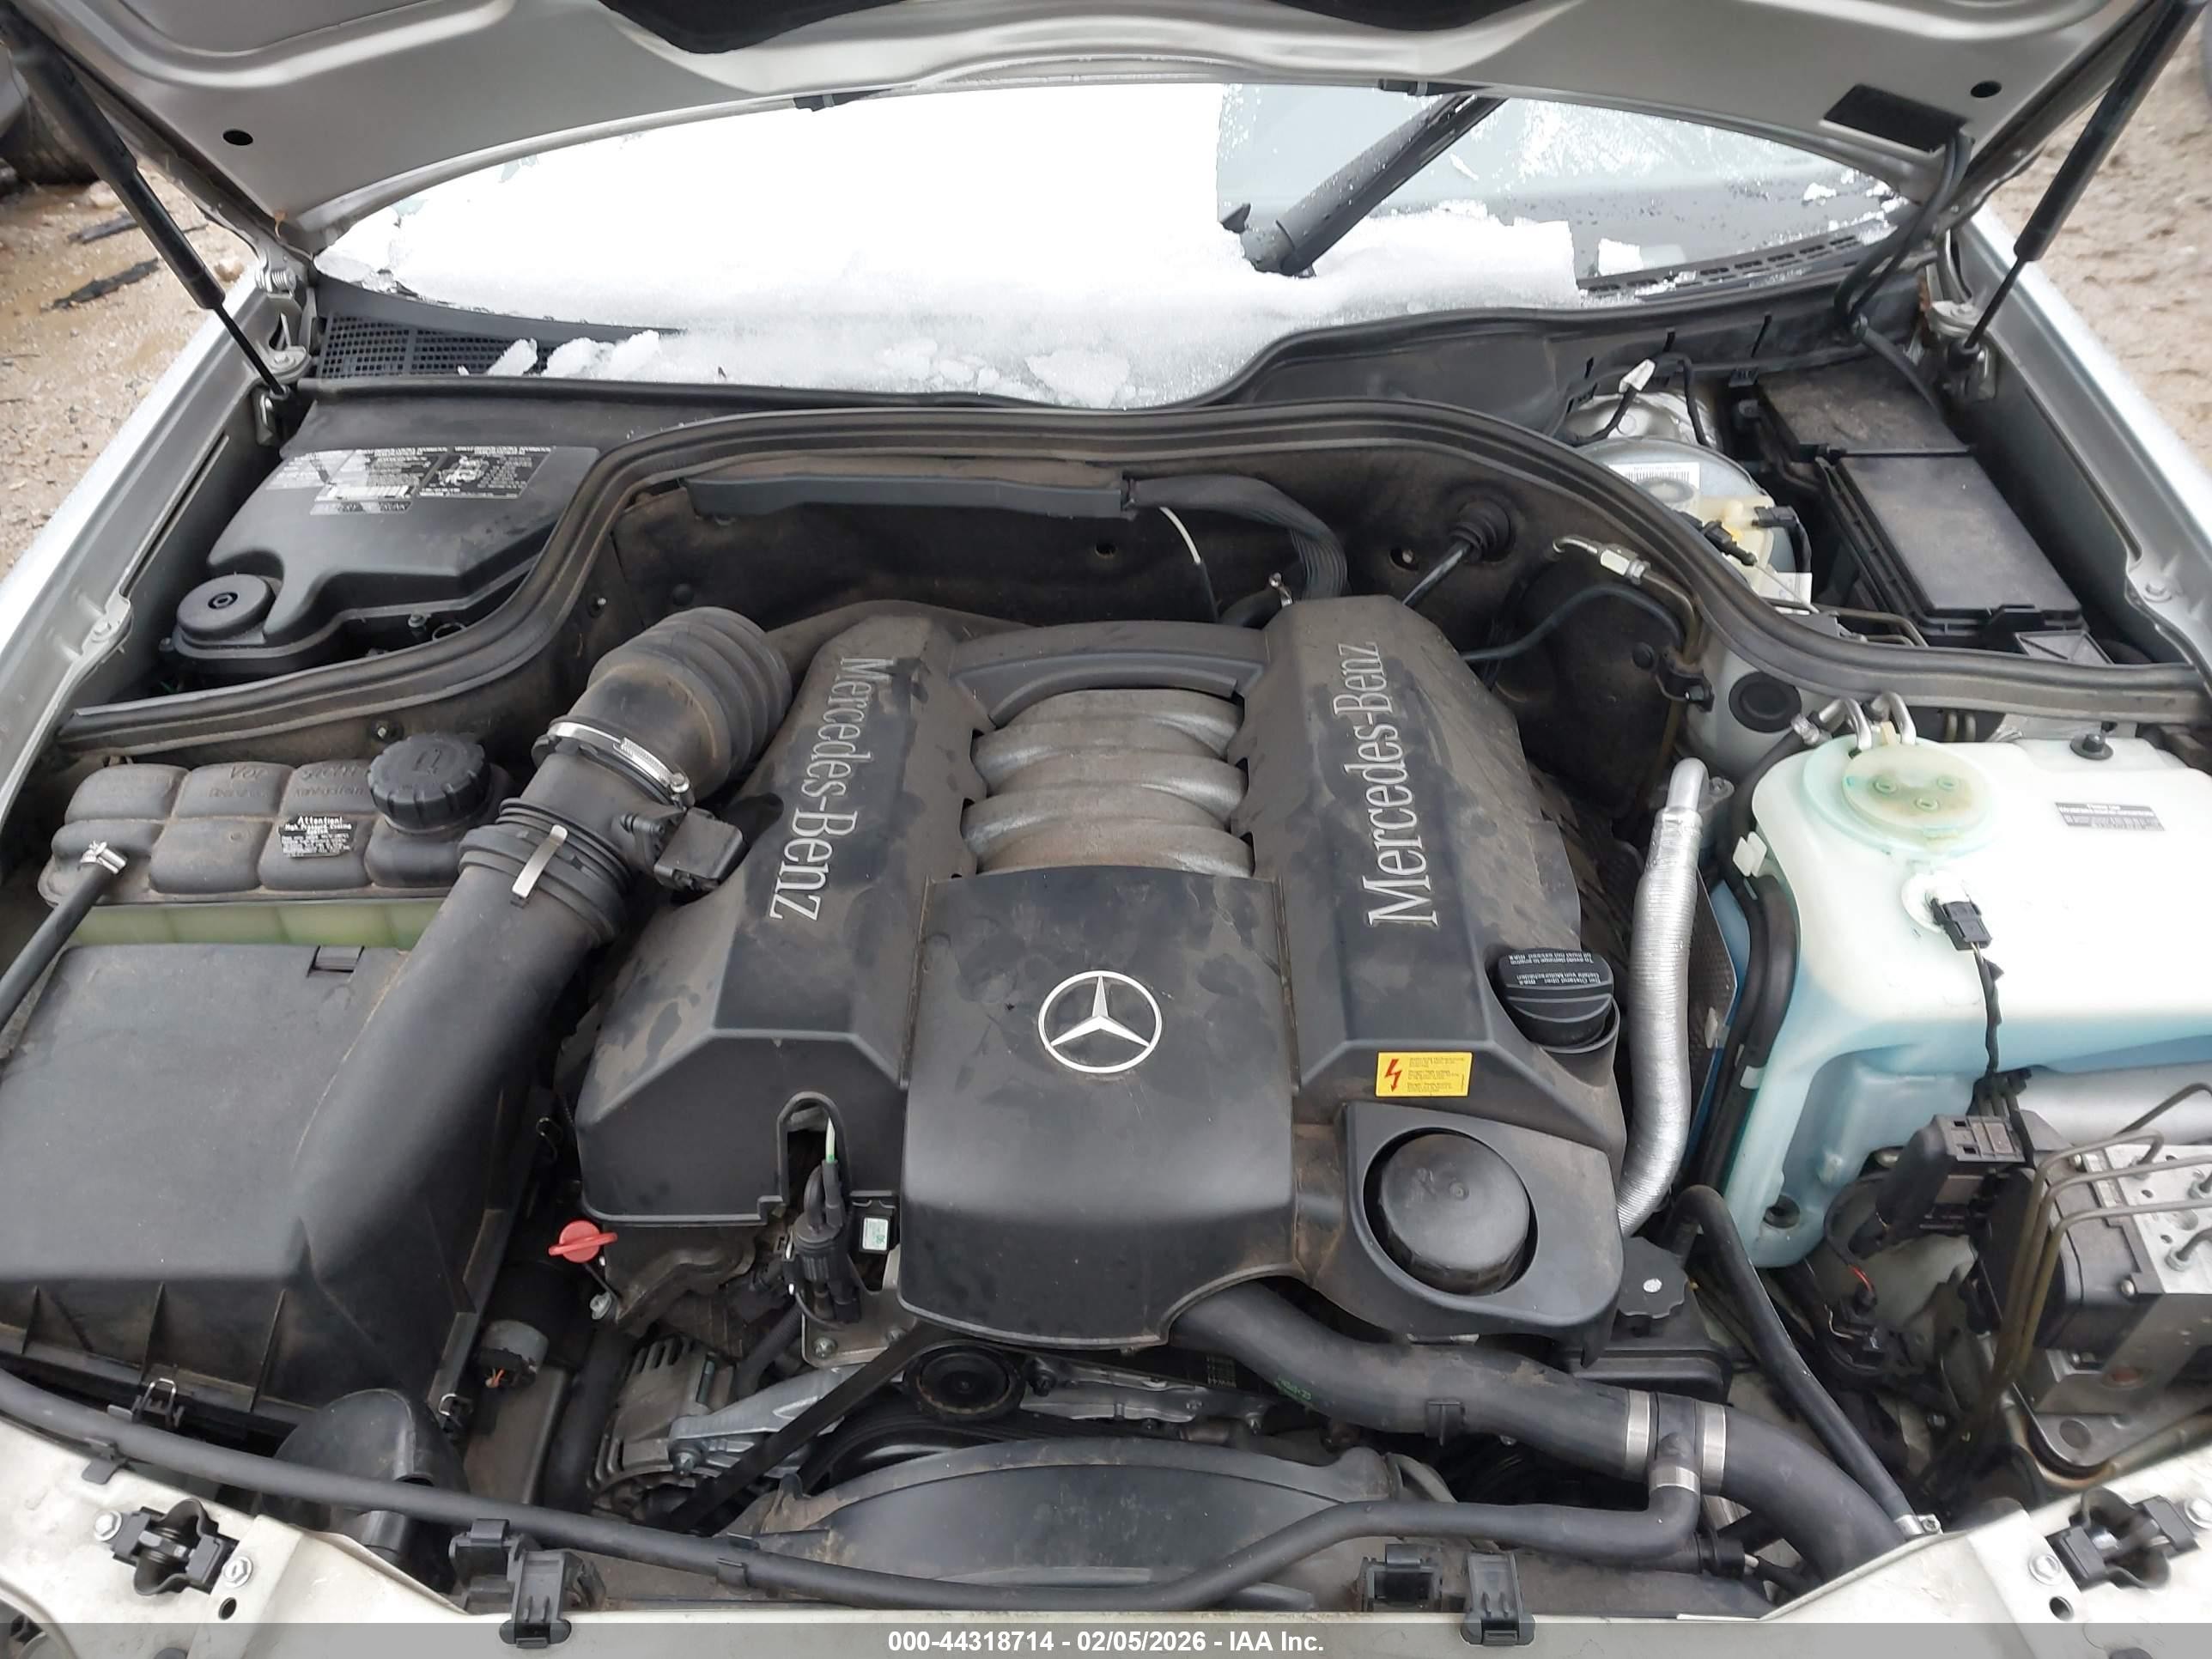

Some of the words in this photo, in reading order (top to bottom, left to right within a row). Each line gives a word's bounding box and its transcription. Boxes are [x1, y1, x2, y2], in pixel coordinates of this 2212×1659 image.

[297, 816, 343, 825] Attention!
[769, 657, 894, 921] Mercedes-Benz
[1333, 641, 1439, 927] Mercedes-Benz
